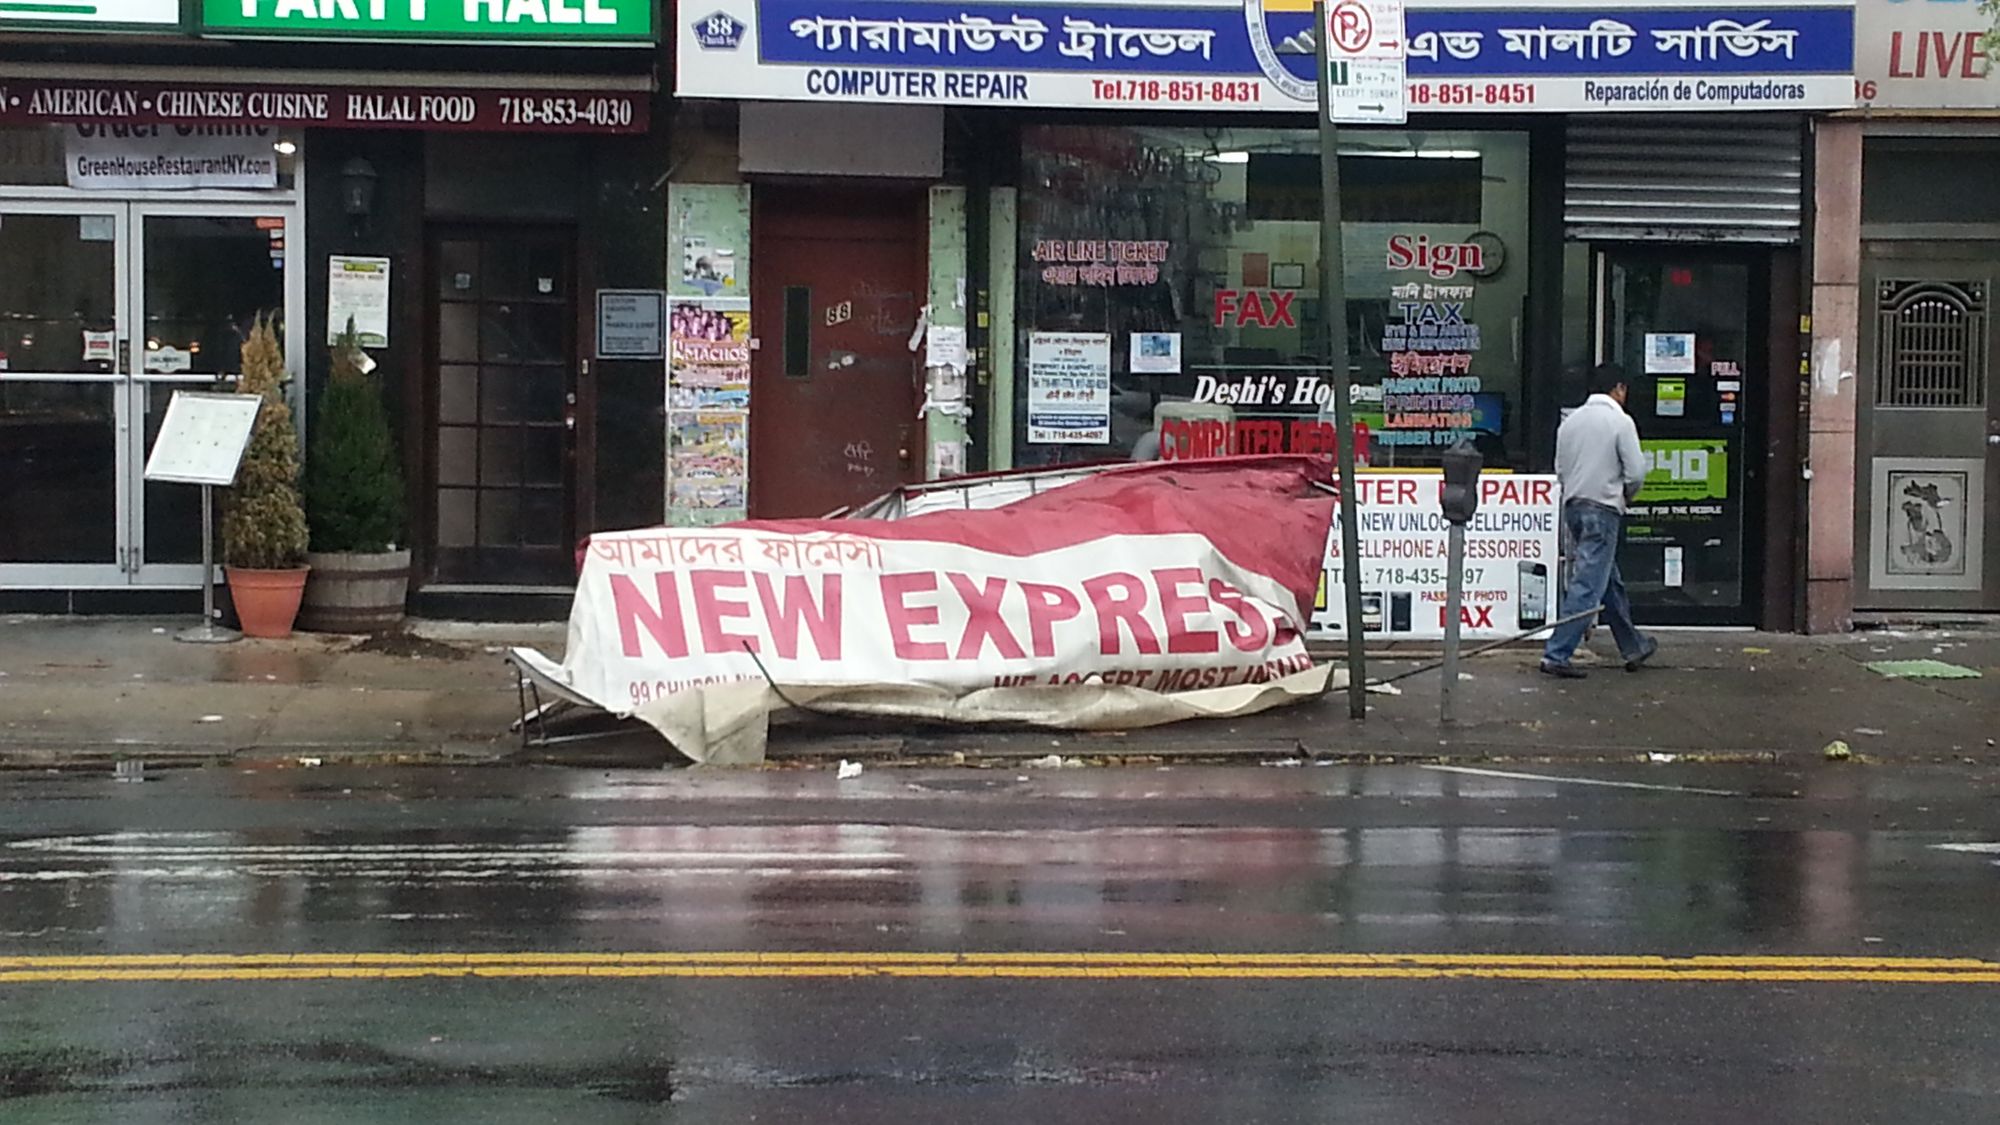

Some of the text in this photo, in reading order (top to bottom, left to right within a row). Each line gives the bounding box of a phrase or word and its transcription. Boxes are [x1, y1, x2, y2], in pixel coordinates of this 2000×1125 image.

[707, 18, 733, 36] 88
[789, 14, 1049, 53] প্যারামাউন্ট
[1059, 16, 1214, 61] ট্রাভেল
[1498, 19, 1637, 60] মালটি
[1650, 18, 1799, 61] সার্ভিস
[1889, 31, 1986, 79] LIVE
[806, 69, 1029, 100] COMPUTER REPAIR
[1408, 83, 1535, 105] 18-851-8451
[1584, 79, 1806, 105] Reparación de Computadoras
[27, 88, 139, 116] AMERICAN
[156, 91, 244, 118] CHINESE
[247, 92, 328, 119] CUISINE
[346, 94, 415, 121] HALAL
[420, 95, 476, 122] FOOD
[498, 97, 632, 126] 718-853-4030
[77, 154, 271, 177] GreenHouseRestaurantNY.com
[1109, 240, 1169, 262] TICKET
[1387, 233, 1484, 279] Sign
[828, 303, 849, 324] 88
[1214, 288, 1296, 329] FAX
[1398, 301, 1464, 325] TAX
[1190, 375, 1286, 404] Deshi's
[1382, 376, 1481, 394] PASSPORT PHOTO
[1383, 394, 1475, 412] PRINTING
[1379, 430, 1432, 445] RUBBER
[1353, 479, 1554, 506] TER PAIR
[1362, 512, 1395, 532] NEW
[1400, 512, 1451, 532] UNLOC
[588, 535, 745, 568] আমাদের
[1357, 540, 1434, 558] ELLPHONE
[1437, 540, 1542, 558] AESSORIES
[1376, 568, 1484, 584] 718-435-97
[1474, 591, 1508, 602] PHOTO
[609, 569, 842, 661] NEW
[1153, 665, 1236, 692] MOST
[630, 681, 650, 706] 99
